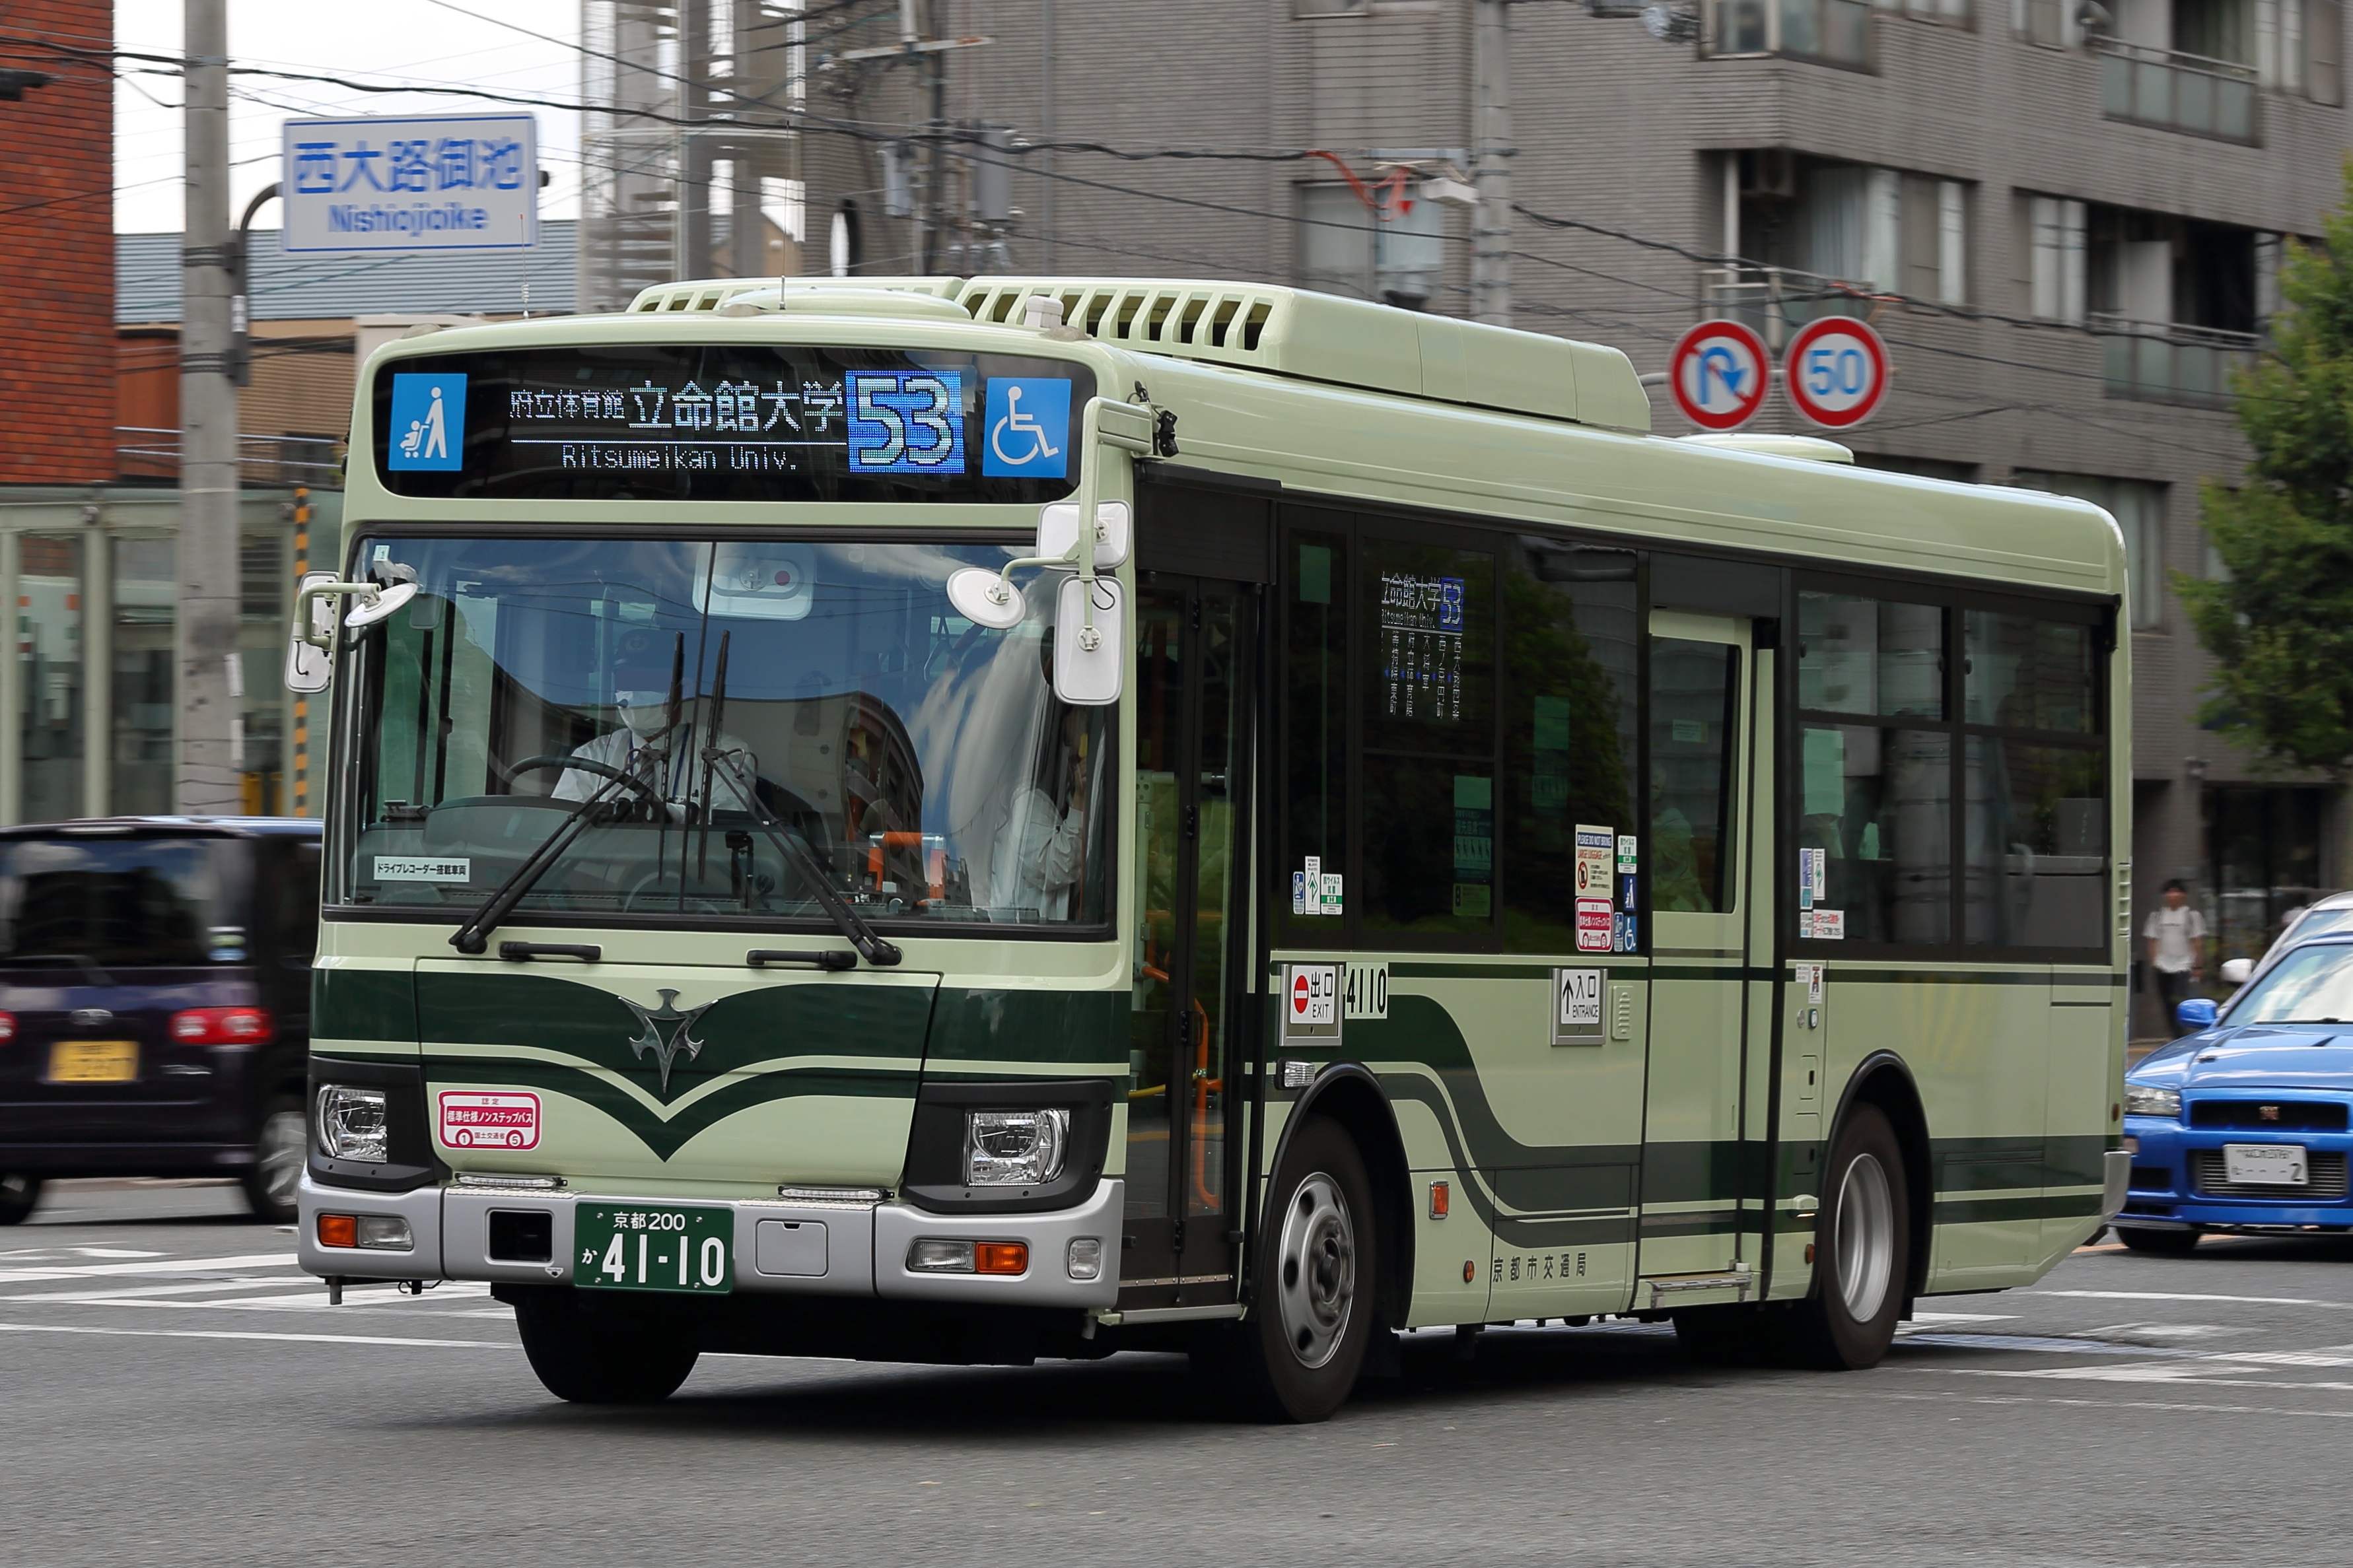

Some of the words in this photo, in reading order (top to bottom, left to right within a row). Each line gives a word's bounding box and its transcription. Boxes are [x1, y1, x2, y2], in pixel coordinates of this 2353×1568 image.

[293, 136, 524, 193] 西大路御池
[328, 202, 489, 237] Nishiojioike
[1808, 349, 1867, 395] 50
[509, 389, 625, 419] 府立体育館
[629, 380, 843, 432] 立命館大学
[857, 377, 953, 465] 53
[562, 444, 717, 469] Ritsumeikan
[730, 446, 796, 470] Univ.
[1442, 582, 1461, 625] 53
[377, 864, 466, 875] ドライブレコーダー搭載車両
[1311, 971, 1333, 998] 出口
[1347, 968, 1387, 1014] 4110
[1576, 974, 1596, 1000] 入口
[1312, 1004, 1329, 1018] EXIT
[1572, 1004, 1598, 1018] ENTRANCE
[447, 1110, 533, 1124] 標準仕様ノンステップバス
[462, 1135, 467, 1143] 1
[512, 1136, 518, 1145] 5
[581, 1248, 598, 1264] か
[602, 1233, 725, 1286] 41-10
[1493, 1252, 1586, 1283] 京都市交通局
